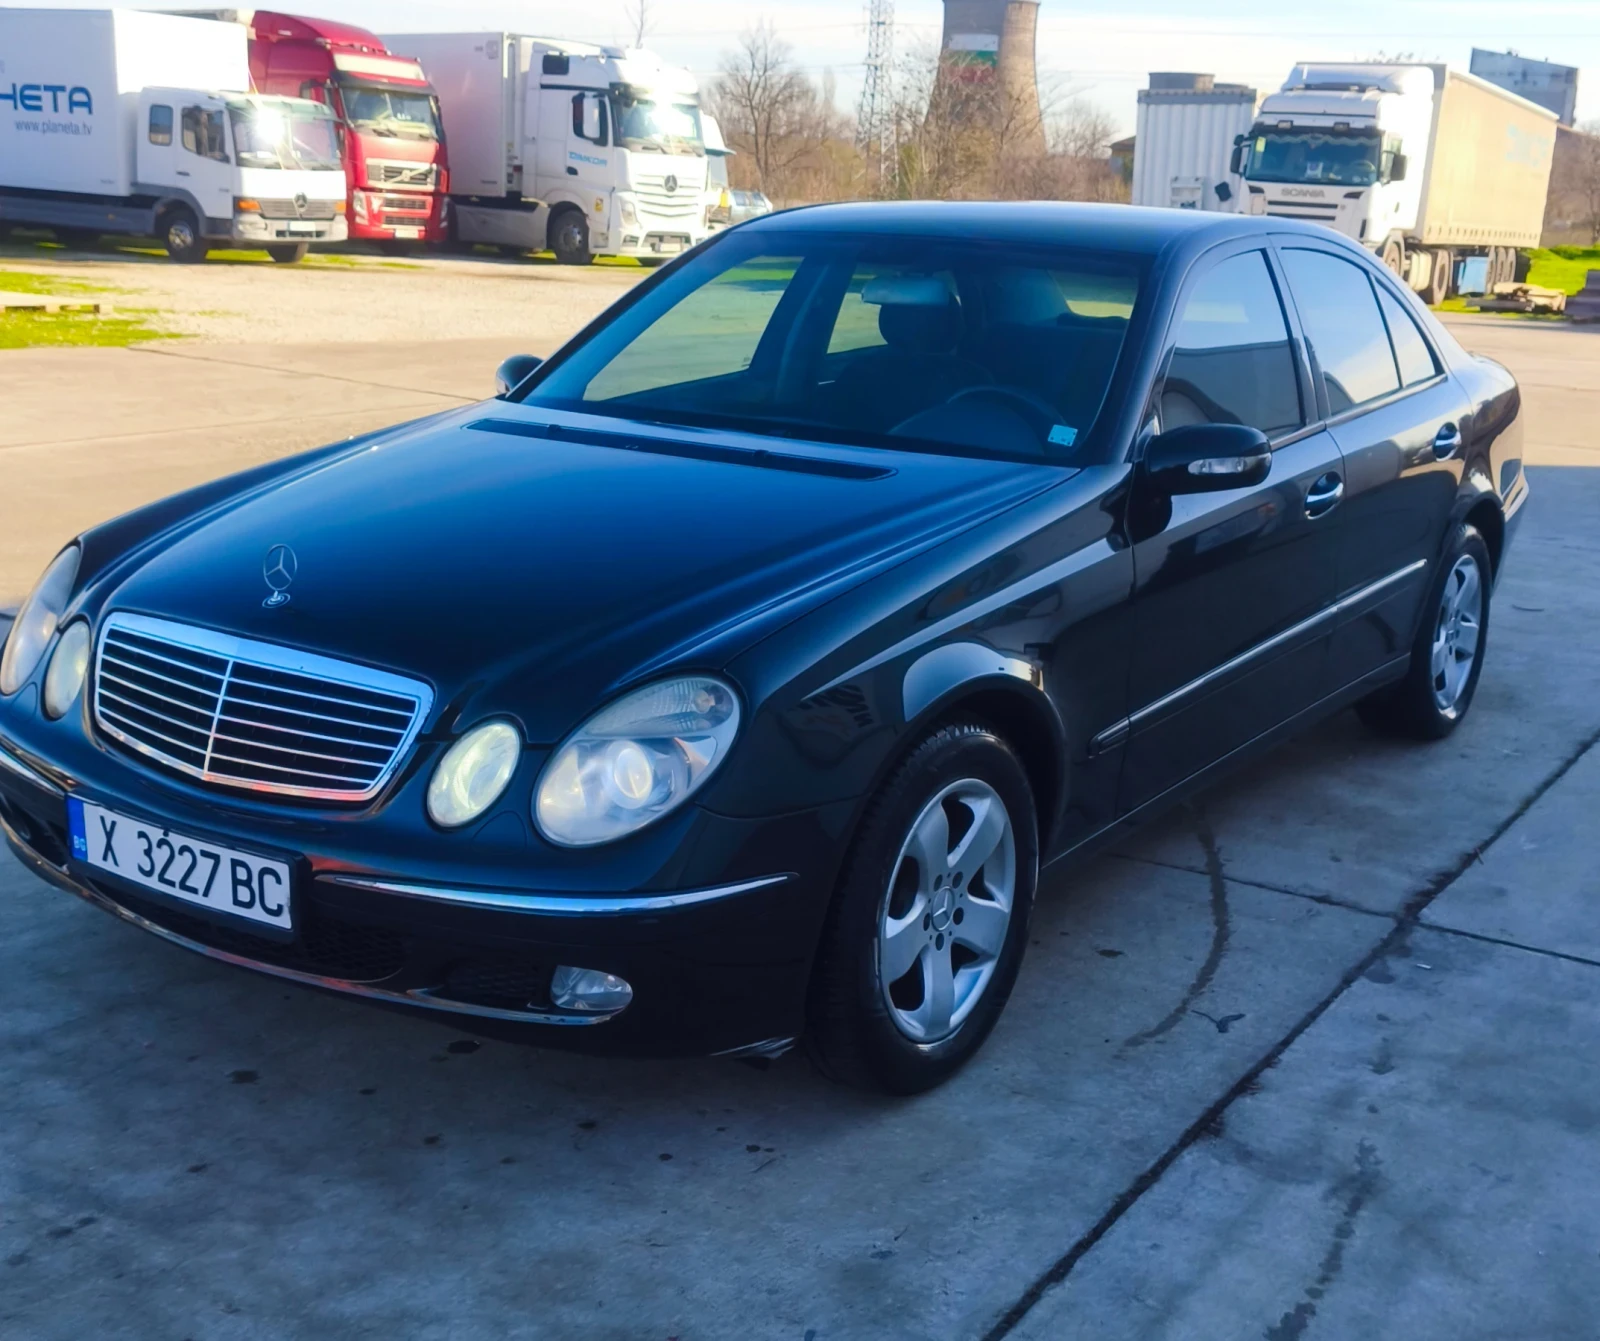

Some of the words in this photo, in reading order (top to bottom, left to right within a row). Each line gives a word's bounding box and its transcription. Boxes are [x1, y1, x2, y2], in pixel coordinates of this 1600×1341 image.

[15, 119, 92, 135] www.planeta.tv
[100, 815, 120, 867] X
[137, 830, 221, 898] 3227
[230, 857, 284, 917] BC
